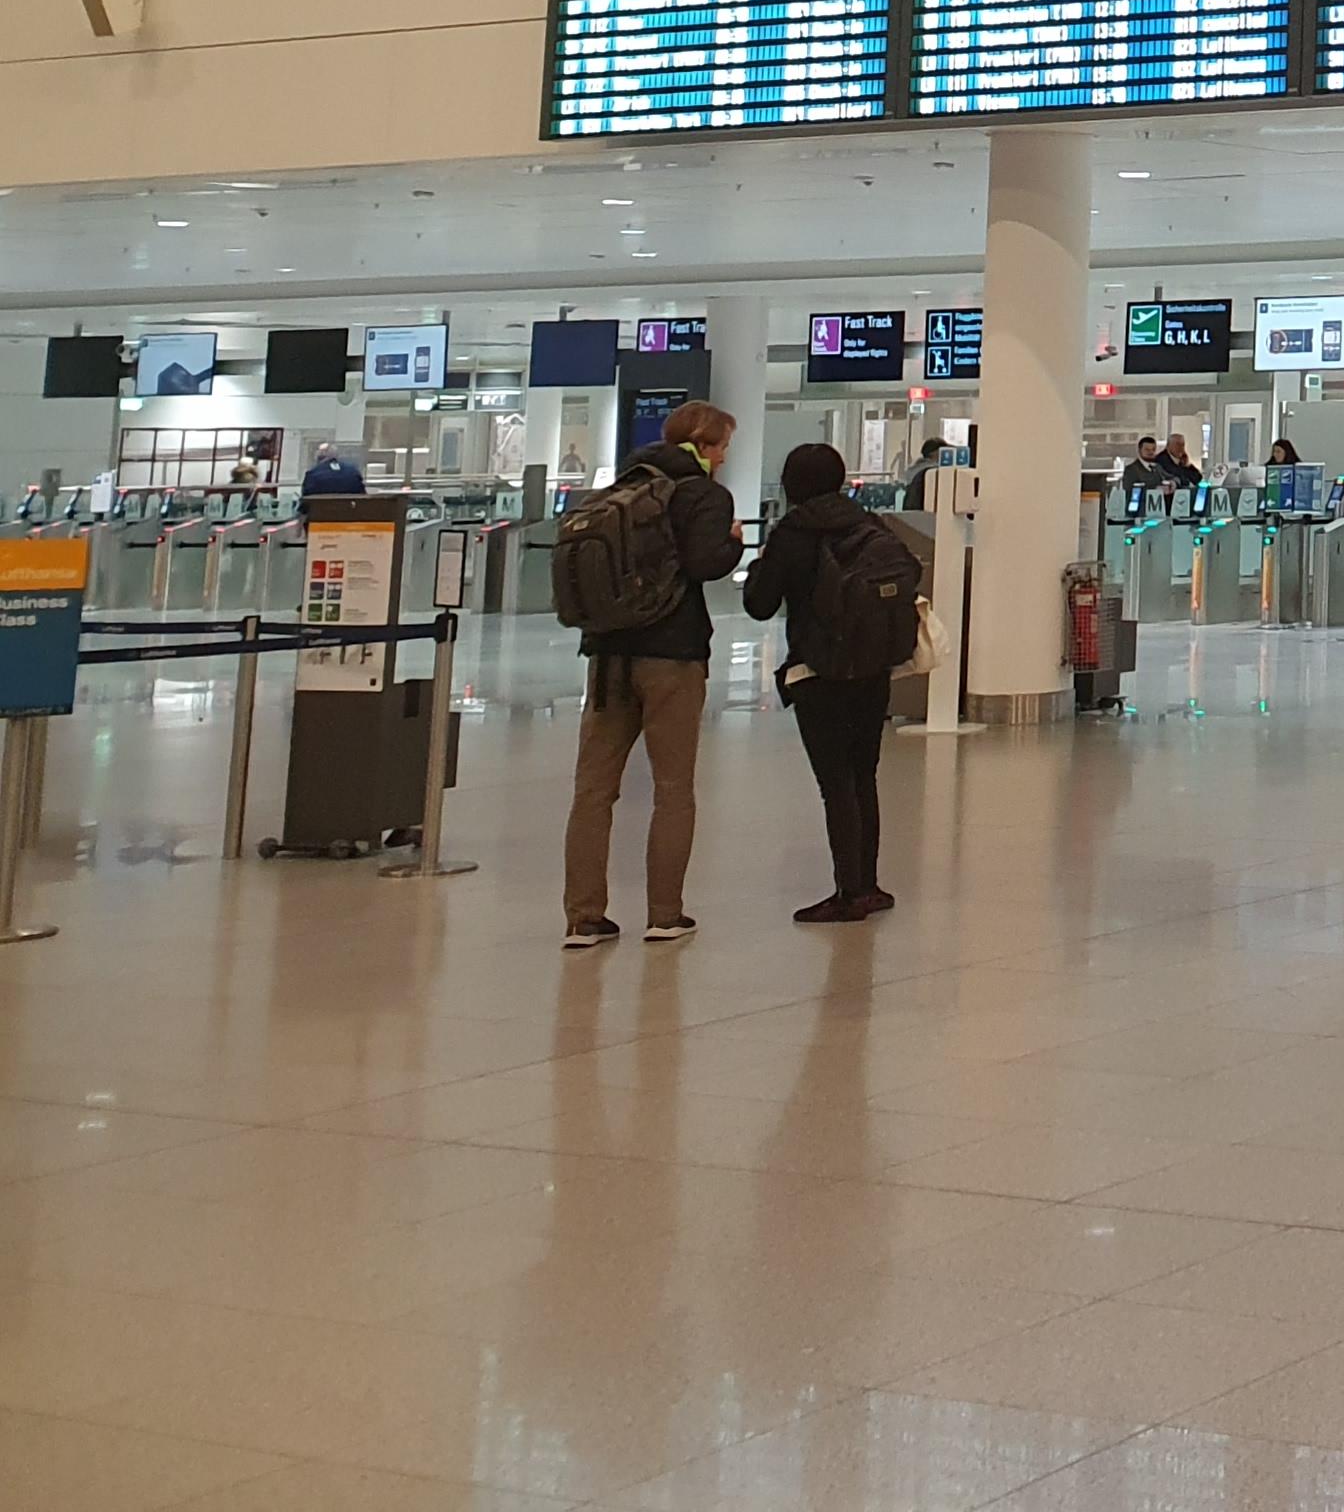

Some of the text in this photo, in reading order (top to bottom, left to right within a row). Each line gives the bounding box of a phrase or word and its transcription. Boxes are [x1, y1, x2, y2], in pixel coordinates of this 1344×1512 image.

[692, 321, 705, 332] Tra
[845, 315, 892, 329] Fast Track
[1164, 330, 1175, 346] G,
[1177, 330, 1188, 346] H,
[1190, 330, 1201, 345] K,
[1203, 329, 1210, 343] L
[1148, 494, 1162, 512] M
[1213, 494, 1227, 512] M
